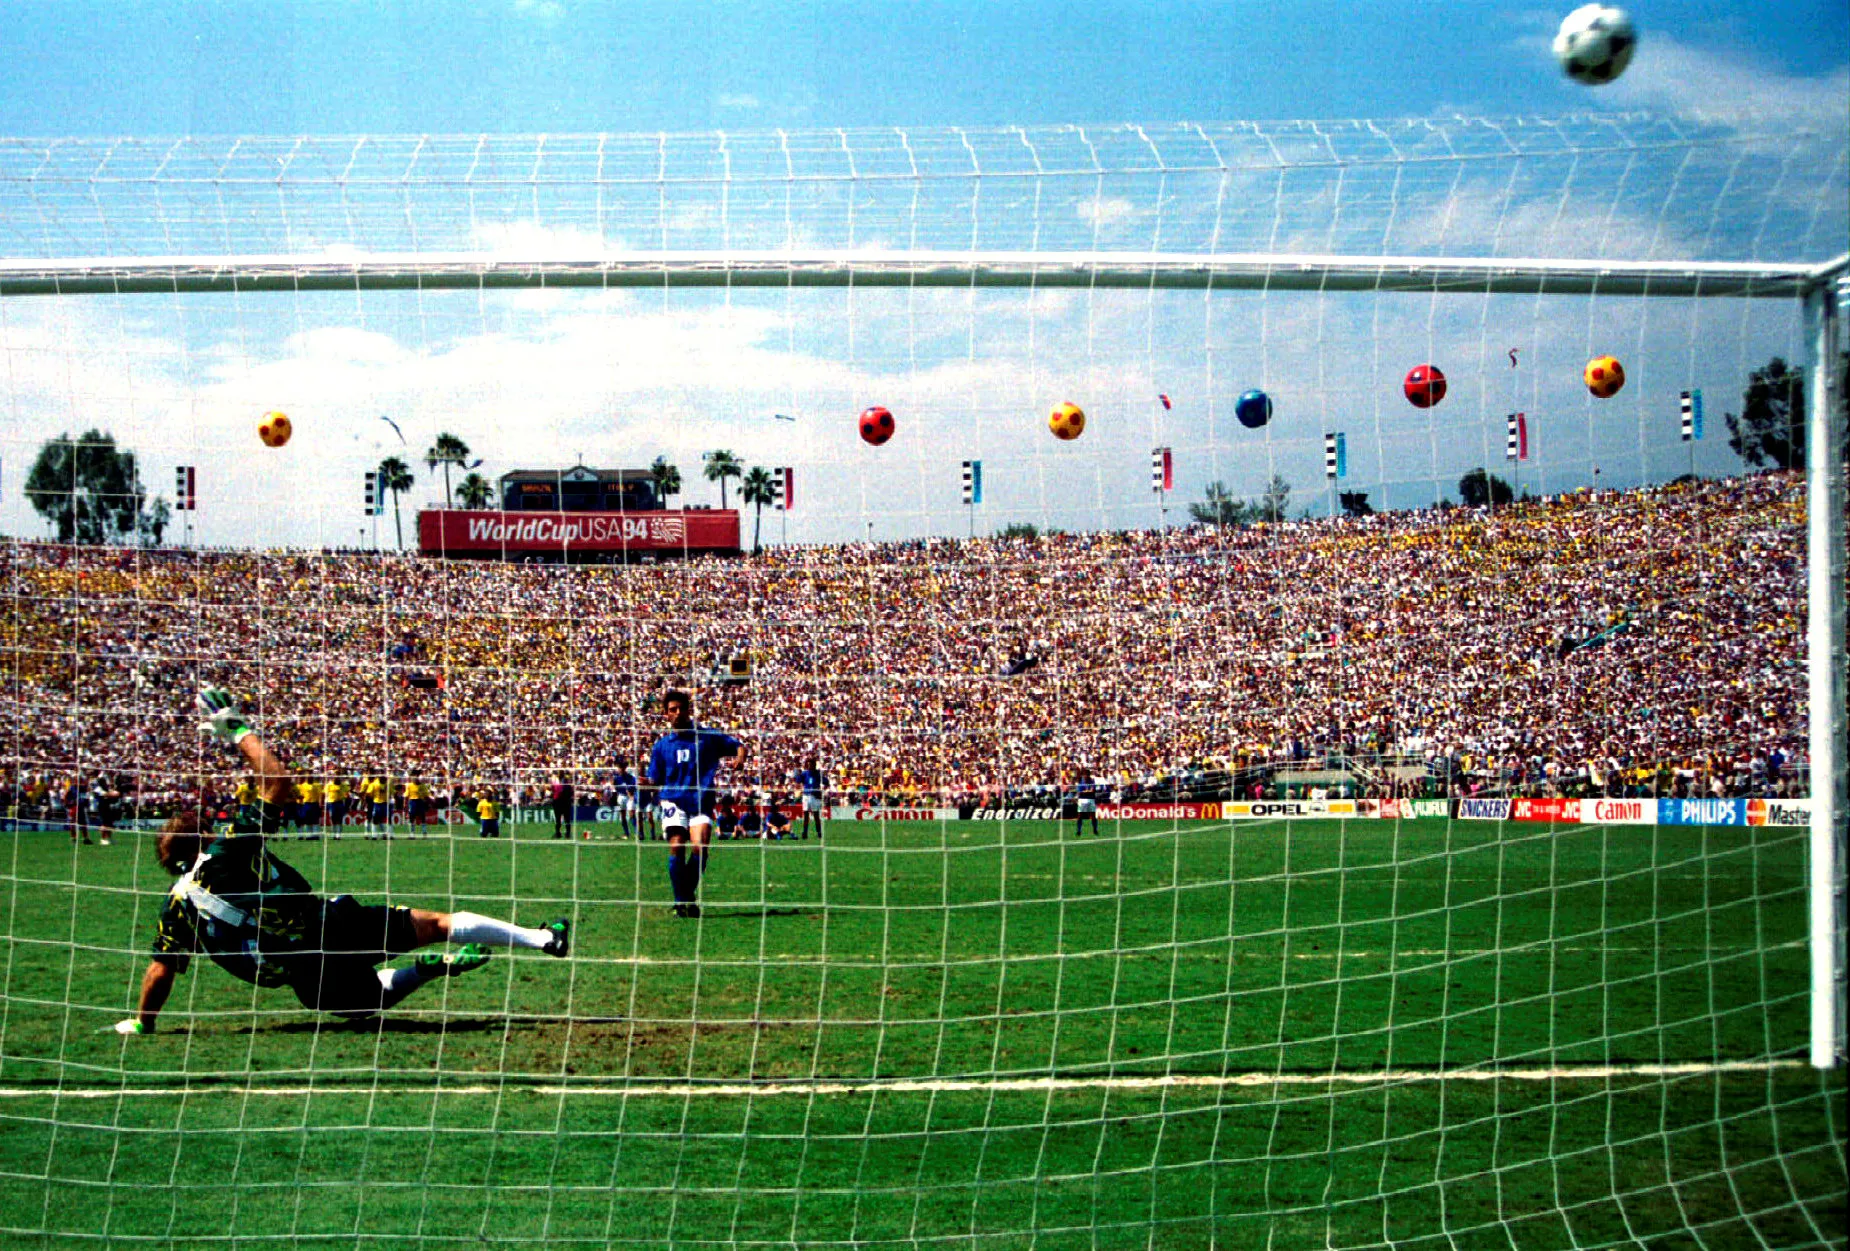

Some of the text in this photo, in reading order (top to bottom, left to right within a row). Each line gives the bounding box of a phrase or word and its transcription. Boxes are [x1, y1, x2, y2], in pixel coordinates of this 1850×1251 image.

[677, 749, 690, 764] 10
[855, 808, 934, 821] Canon
[971, 806, 1062, 820] Energizer
[1095, 804, 1196, 819] McDonald's
[1251, 804, 1308, 816] OPEL
[1460, 799, 1508, 818] SNICKERS
[1515, 801, 1531, 817] JVC
[1562, 801, 1580, 818] JVC
[1595, 801, 1641, 820] Canon
[1681, 802, 1736, 825] PHILIPS
